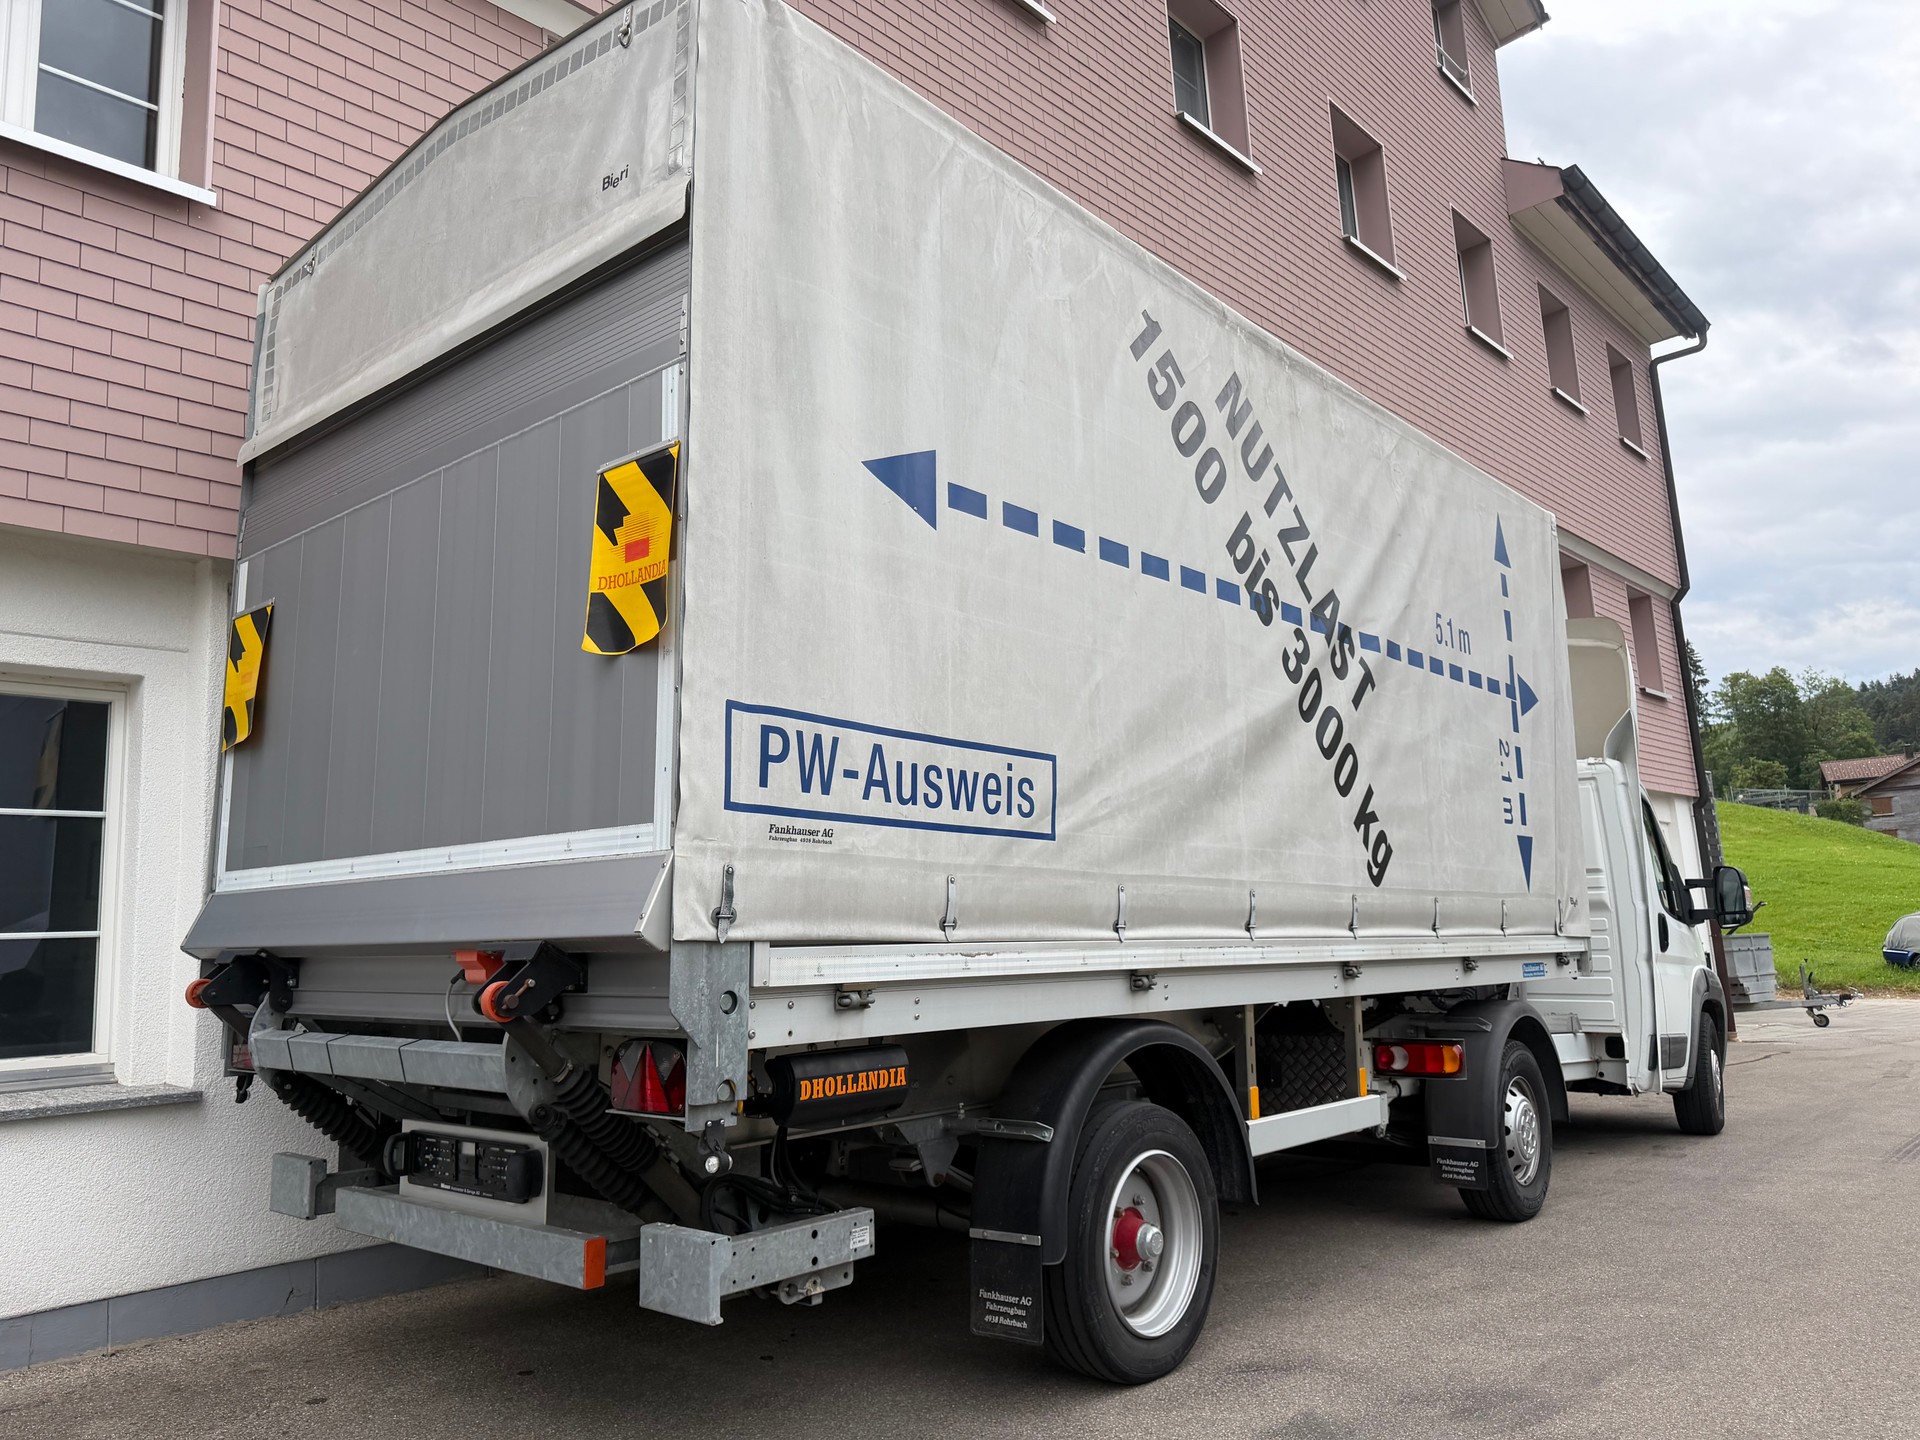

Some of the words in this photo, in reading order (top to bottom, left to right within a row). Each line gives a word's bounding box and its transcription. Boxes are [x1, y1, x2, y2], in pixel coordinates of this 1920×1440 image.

[602, 164, 629, 192] Bieri
[1215, 371, 1375, 711] NUTZLAST
[597, 559, 667, 591] DHOLLANDIA
[1129, 309, 1227, 504] 1500
[1225, 511, 1279, 627] bis
[1282, 627, 1359, 798] 3000
[1353, 784, 1393, 887] kg
[1435, 612, 1455, 649] 5.1
[1458, 627, 1471, 655] m
[758, 723, 1036, 818] PW-Ausweis
[1498, 738, 1513, 783] 2.1
[1502, 797, 1514, 825] m
[768, 823, 821, 837] Fankhauser
[821, 828, 834, 838] AG
[799, 1067, 907, 1101] DHOLLANDIA
[979, 1289, 1019, 1304] Fankhauser
[1020, 1296, 1032, 1306] AG
[986, 1301, 1026, 1316] Fahrzeugbau
[984, 1315, 999, 1324] 4938
[999, 1316, 1028, 1329] Rohrbach
